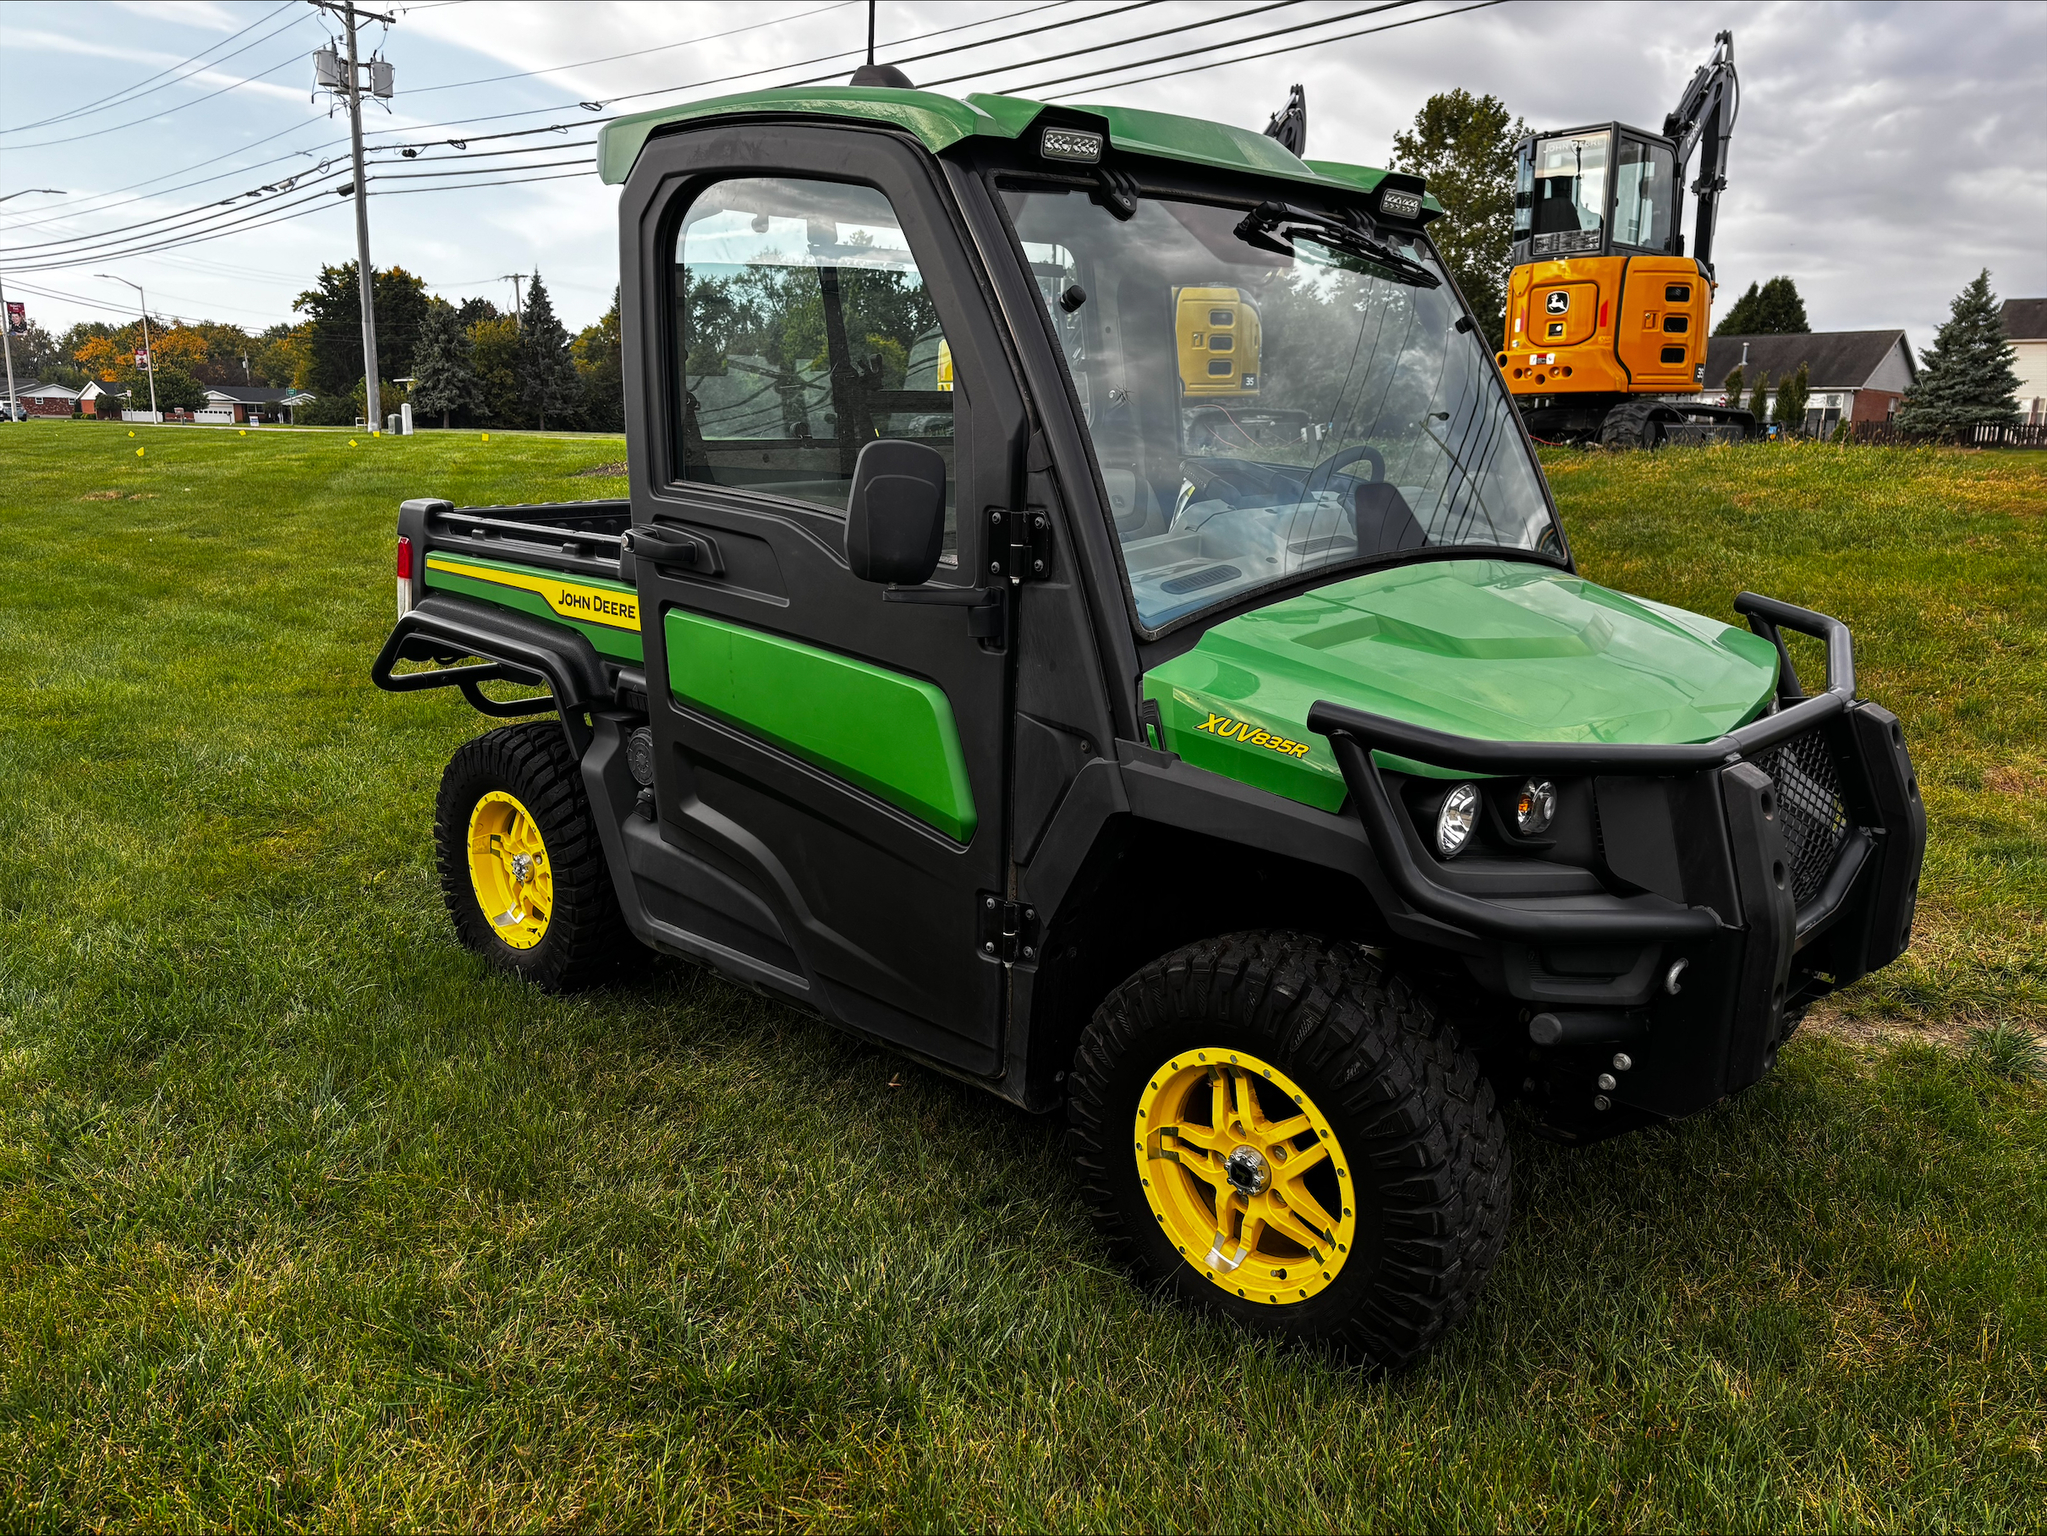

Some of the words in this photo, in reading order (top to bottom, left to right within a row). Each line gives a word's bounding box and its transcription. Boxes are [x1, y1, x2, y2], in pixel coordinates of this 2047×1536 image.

[1543, 142, 1569, 154] JOHN
[1246, 377, 1254, 385] 35
[559, 590, 590, 610] JOHN
[594, 596, 635, 619] DEERE
[1195, 712, 1310, 759] XUV835R
